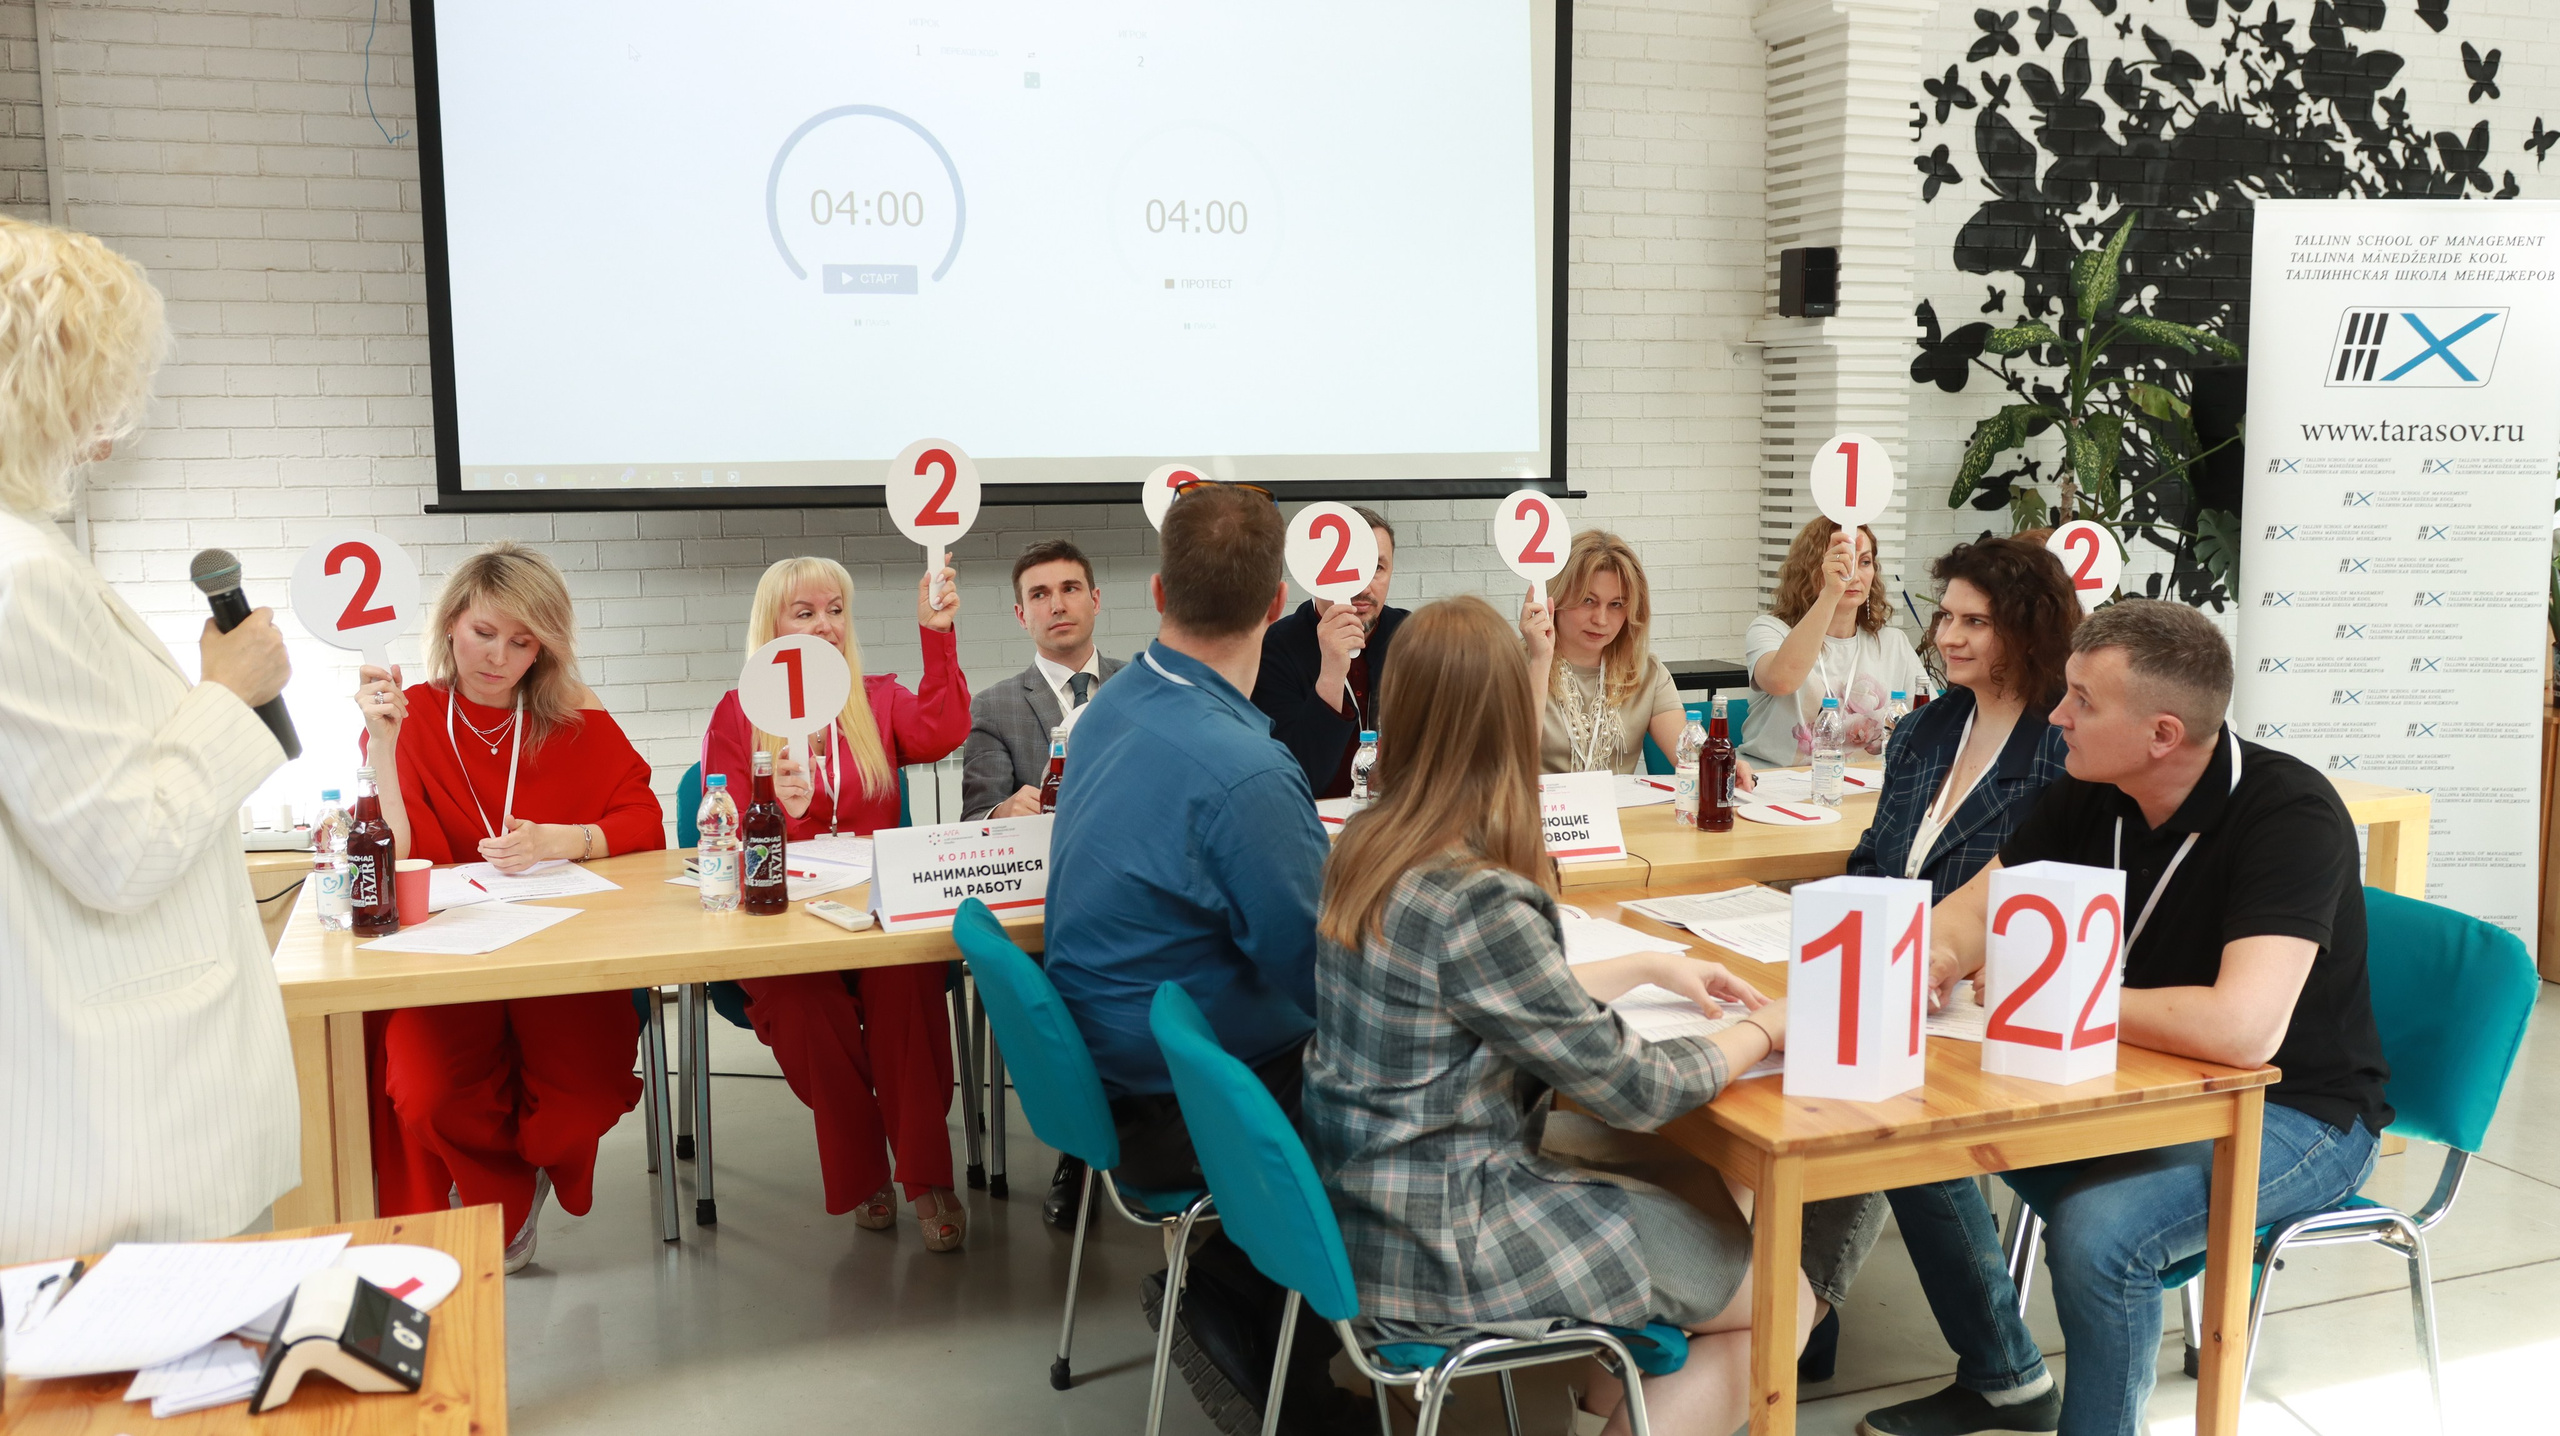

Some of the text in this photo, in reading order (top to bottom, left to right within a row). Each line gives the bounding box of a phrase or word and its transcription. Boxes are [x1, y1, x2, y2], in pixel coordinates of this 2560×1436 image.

[1137, 55, 1145, 68] 2
[809, 188, 925, 228] 04:00
[1144, 198, 1249, 236] 04:00
[2290, 252, 2355, 264] TALLINNA
[2469, 253, 2508, 264] KOOL
[2294, 234, 2546, 248] TALLINN SCHOOL OF MANAGEMENT
[859, 272, 899, 286] СТАРТ
[1180, 277, 1233, 291] ПРОТЕСТ
[2286, 269, 2556, 283] ТАЛЛИННСКАЯ ШКОЛА МЕНЕДЖЕРОВ
[2302, 420, 2526, 443] www.tarasov.ru
[914, 448, 960, 527] 2
[1836, 441, 1859, 508] 1
[1309, 513, 1361, 586] 2
[1515, 498, 1555, 564] 2
[2064, 527, 2103, 591] 2
[324, 541, 397, 631] 2
[771, 647, 806, 720] 1
[912, 859, 1043, 884] НАНИМАЮЩИЕСЯ
[938, 847, 1015, 862] КОЛЛЕГИЯ
[943, 879, 1022, 898] НА РАБОТУ
[1801, 910, 1863, 1067] 1
[1892, 902, 1924, 1057] 1
[1985, 893, 2068, 1051] 2
[2070, 893, 2122, 1051] 2
